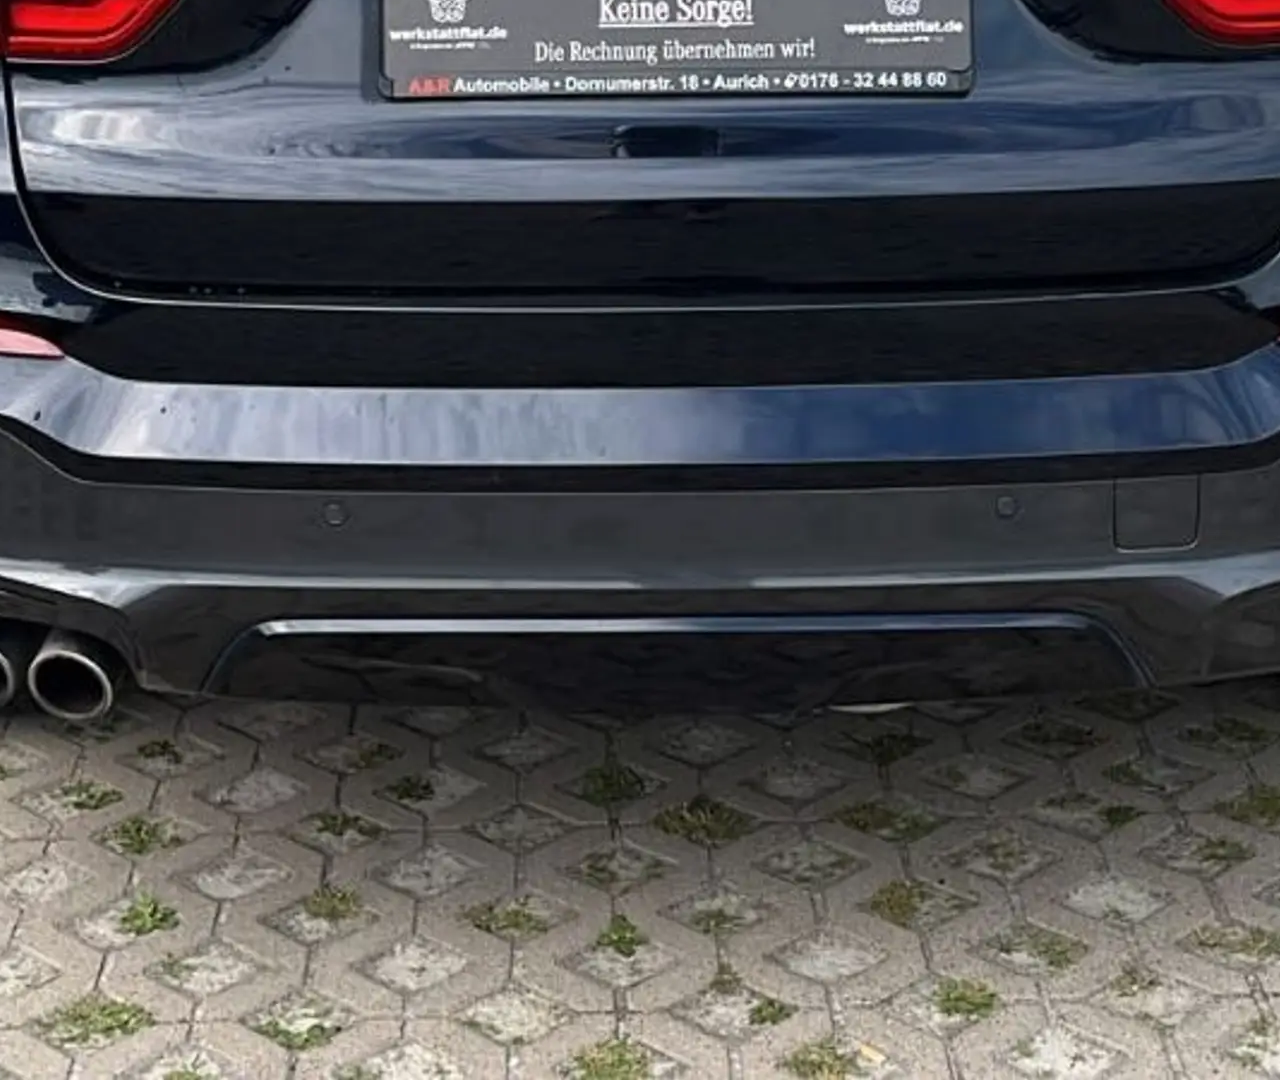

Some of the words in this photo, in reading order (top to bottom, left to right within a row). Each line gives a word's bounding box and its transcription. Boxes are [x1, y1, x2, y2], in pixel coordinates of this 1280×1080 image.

[389, 26, 508, 41] werkstattflat.de
[843, 20, 964, 35] werkstattflat.de
[534, 42, 565, 62] Die
[569, 40, 658, 66] Rechnung
[663, 38, 774, 61] übernehmen
[780, 37, 816, 58] wir!
[453, 76, 550, 93] Automobile
[713, 72, 769, 91] Aurich
[853, 72, 874, 88] 32
[877, 72, 898, 87] 44
[902, 72, 922, 88] 88
[926, 71, 947, 87] 60
